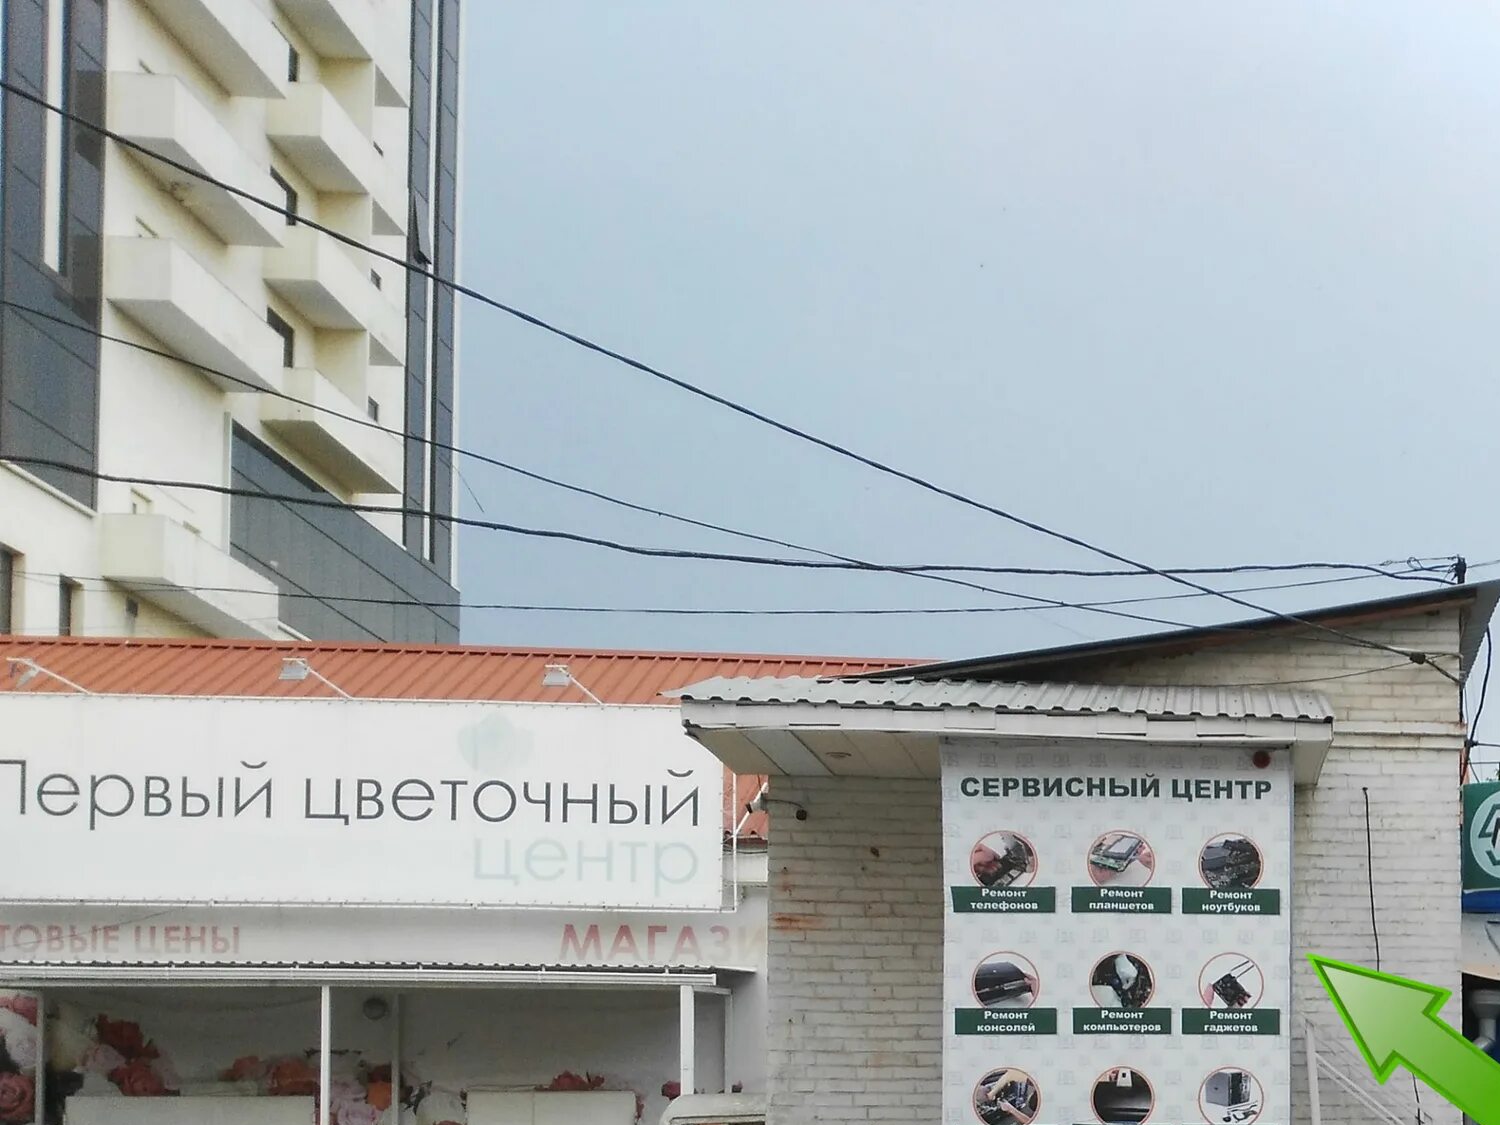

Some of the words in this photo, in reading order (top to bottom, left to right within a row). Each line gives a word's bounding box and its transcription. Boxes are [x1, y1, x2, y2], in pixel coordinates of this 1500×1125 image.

[960, 773, 1160, 798] СЕРВИСНЫЙ
[1171, 777, 1273, 802] ЦЕНТР
[304, 768, 699, 827] цветочный
[472, 836, 699, 898] центр
[981, 887, 1027, 899] Ремонт
[1100, 887, 1144, 899] Ремонт
[1210, 889, 1253, 900] Ремонт
[970, 899, 1039, 911] телефонов
[1089, 900, 1154, 911] планшетов
[1202, 902, 1260, 914] ноутбуков
[135, 924, 240, 956] ЦЕНЫ
[984, 1009, 1028, 1020] Ремонт
[1101, 1009, 1144, 1020] Ремонт
[1210, 1010, 1253, 1021] Ремонт
[977, 1020, 1036, 1033] консолей
[1083, 1021, 1162, 1033] компьютеров
[1204, 1022, 1259, 1034] гаджетов
